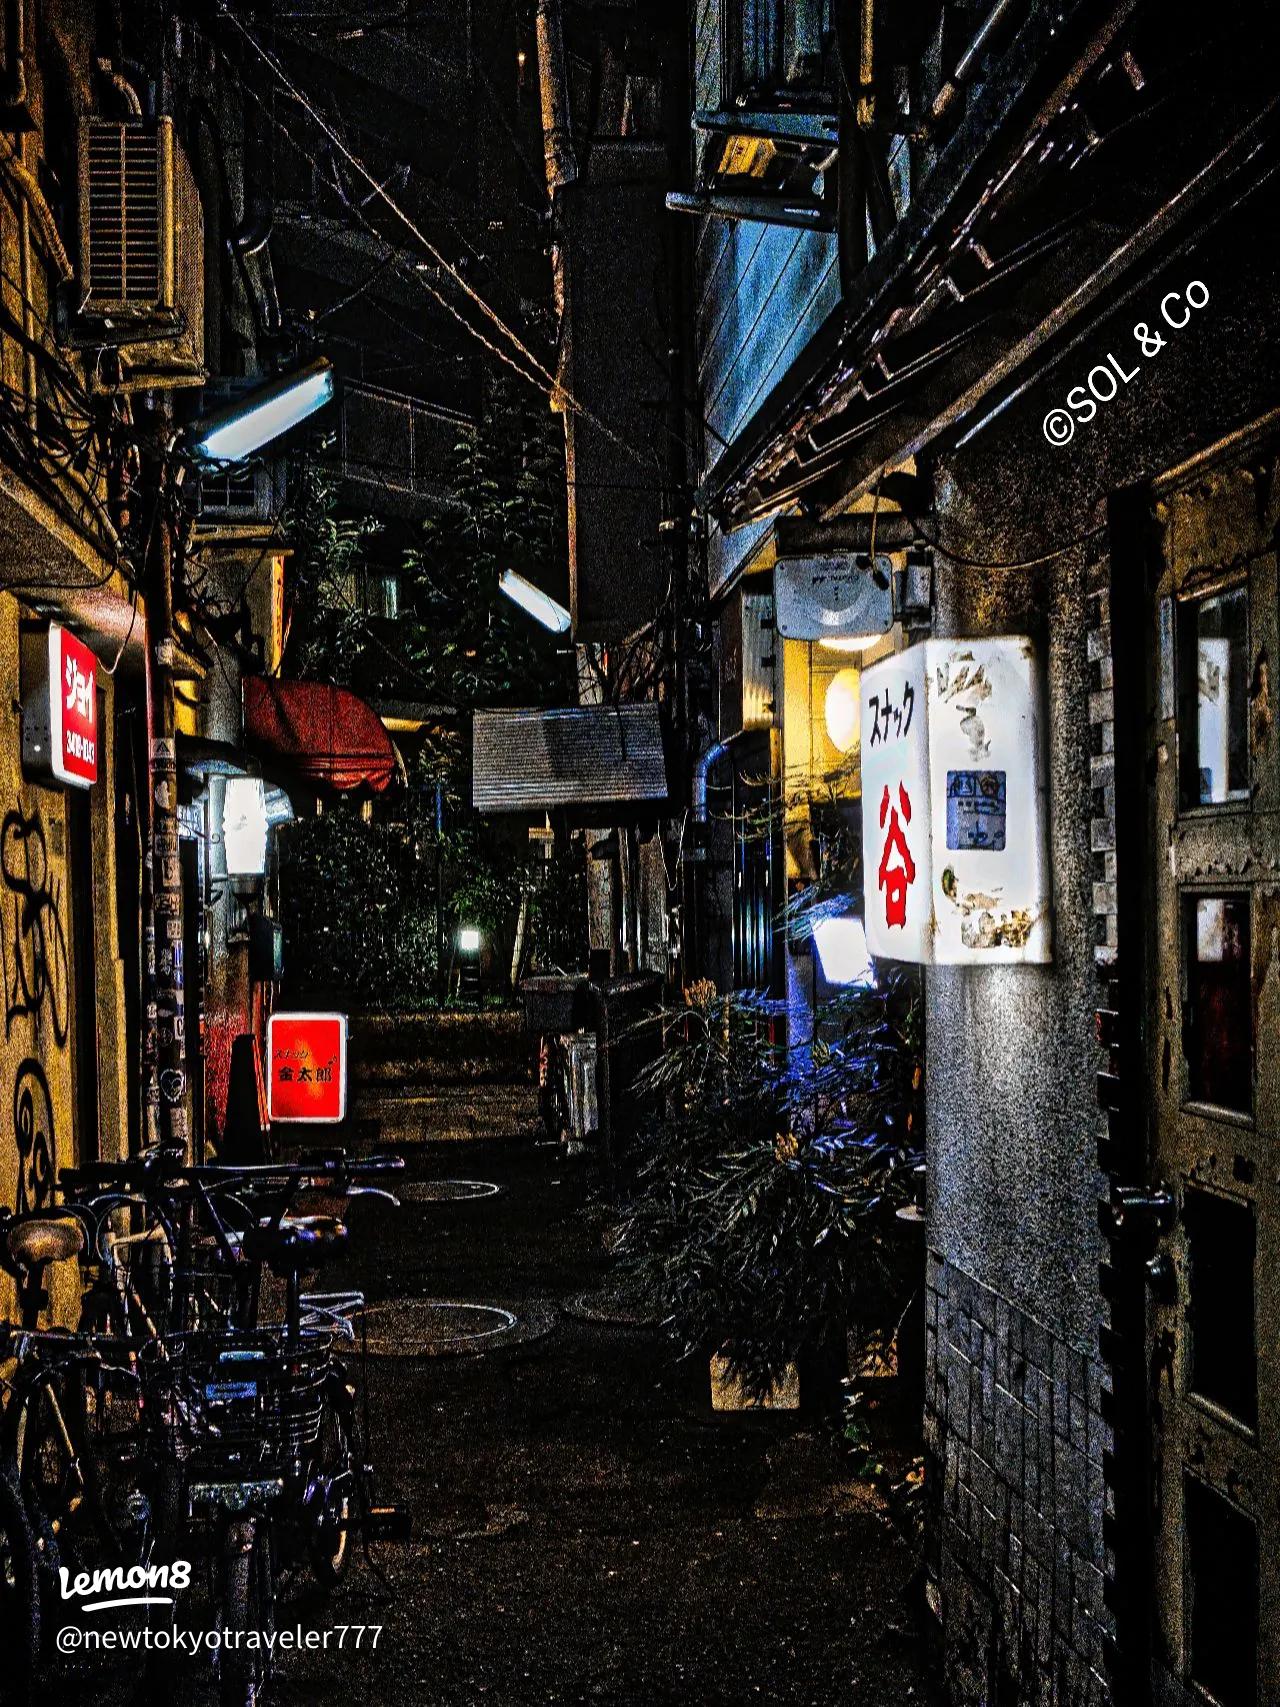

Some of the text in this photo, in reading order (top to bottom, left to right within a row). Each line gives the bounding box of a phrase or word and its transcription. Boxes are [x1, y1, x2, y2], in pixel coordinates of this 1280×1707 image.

[868, 680, 915, 747] スナック
[278, 1066, 332, 1083] 金太郎
